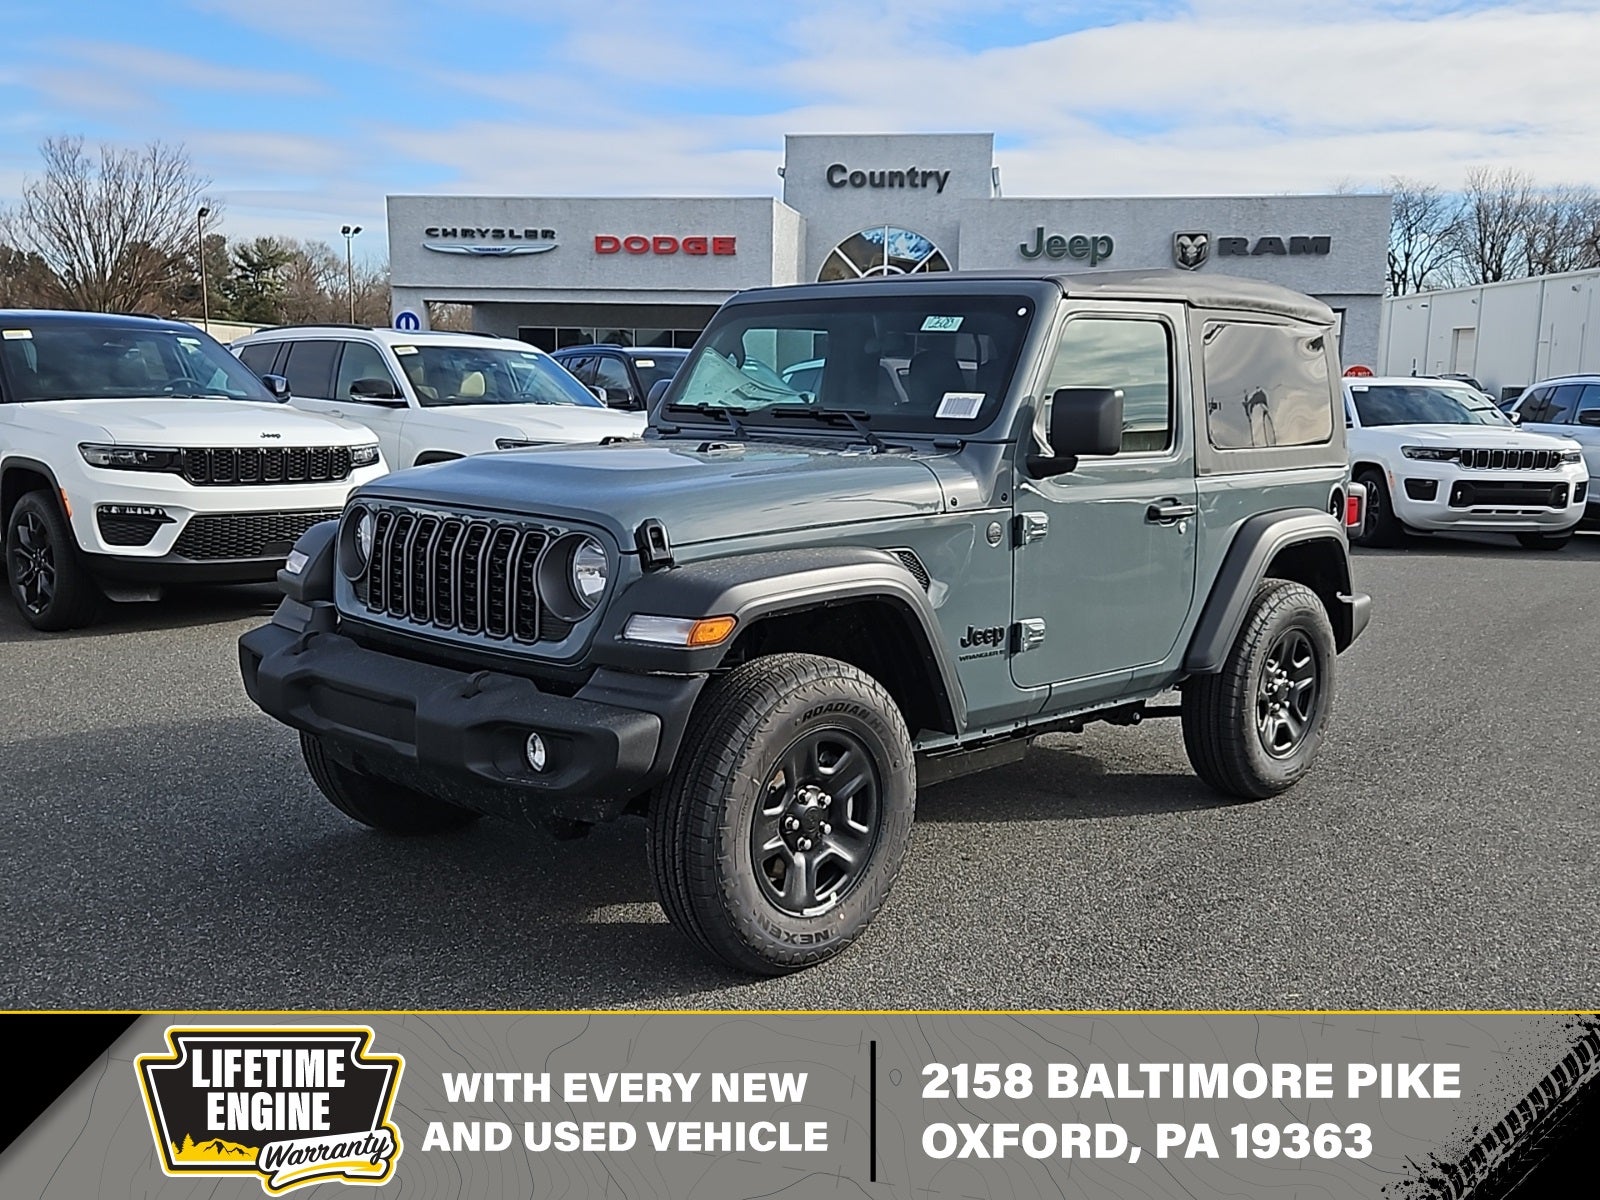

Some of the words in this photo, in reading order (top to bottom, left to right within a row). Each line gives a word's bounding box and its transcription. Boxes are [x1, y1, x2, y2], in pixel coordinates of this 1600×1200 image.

[826, 163, 951, 194] Country
[424, 227, 557, 240] CHRYSLER
[595, 235, 737, 256] DODGE
[1019, 226, 1114, 267] Jeep
[1217, 236, 1332, 256] RAM
[960, 625, 1005, 648] Jeep
[959, 650, 999, 662] WRANGLER
[802, 702, 871, 723] ROADIAN
[757, 914, 830, 945] NEXEN
